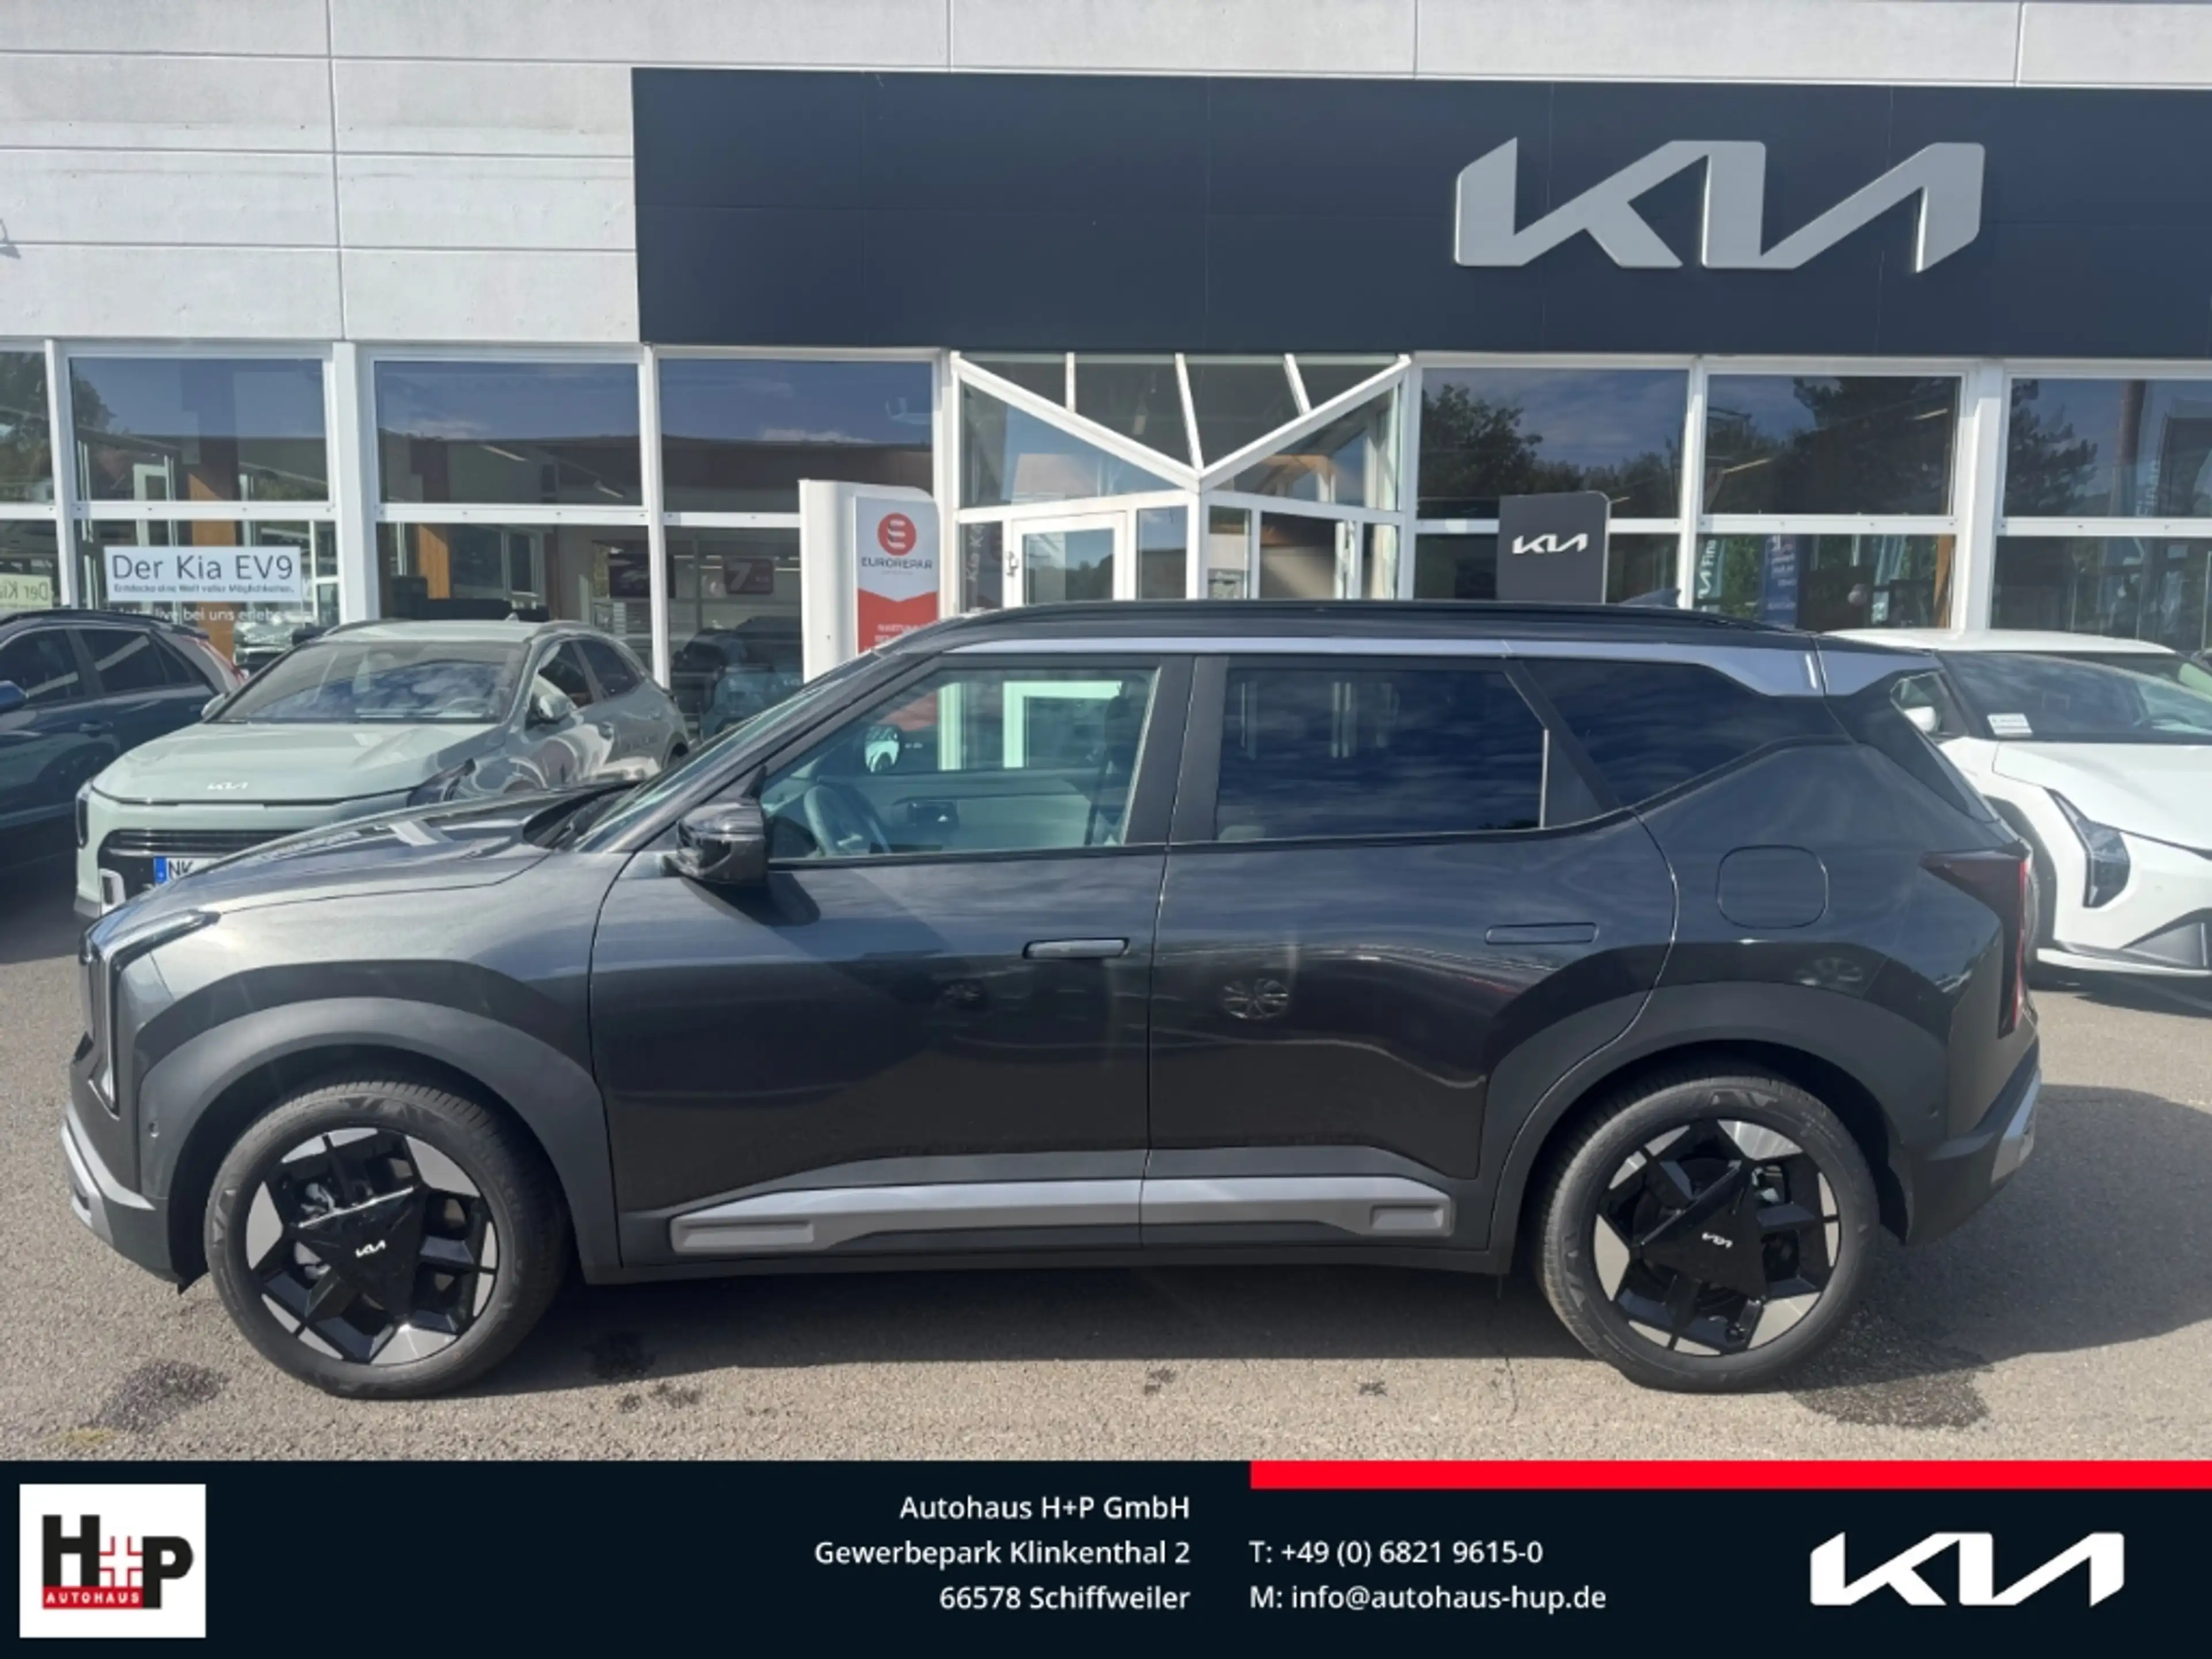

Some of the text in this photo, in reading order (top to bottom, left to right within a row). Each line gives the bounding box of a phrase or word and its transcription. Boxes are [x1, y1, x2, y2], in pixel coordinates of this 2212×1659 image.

[1455, 137, 1986, 273] KIA
[1512, 533, 1588, 554] KIA
[112, 555, 293, 579] Der Kia EV9
[861, 556, 933, 570] EUROREPAR
[183, 607, 204, 621] bei
[209, 611, 235, 622] uns
